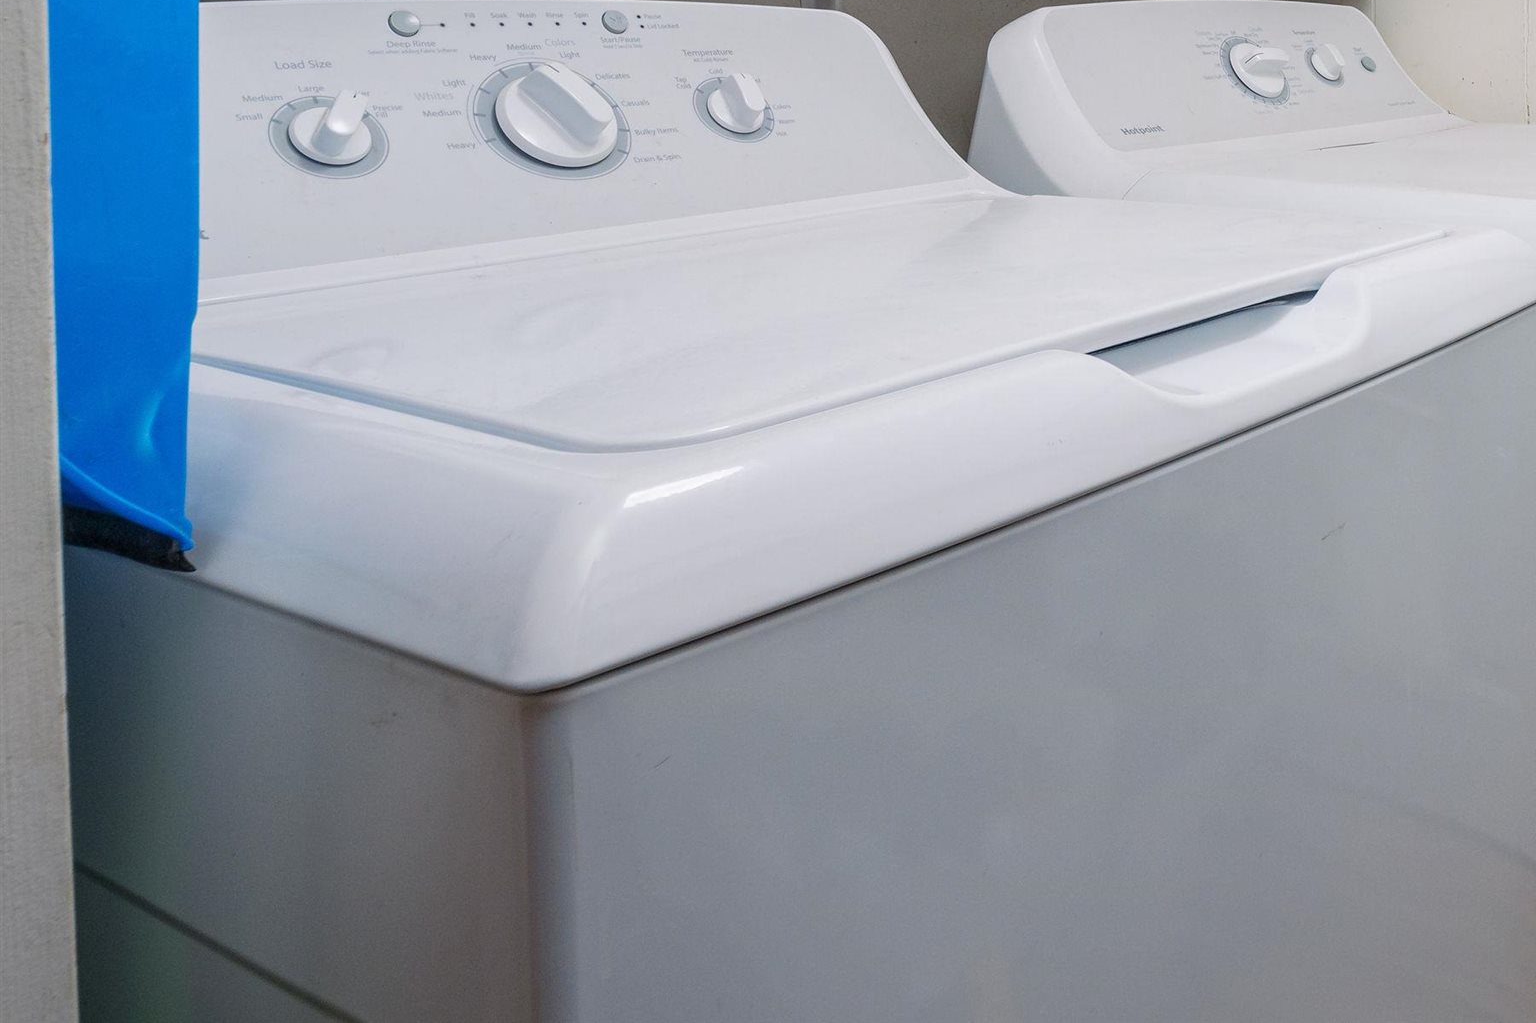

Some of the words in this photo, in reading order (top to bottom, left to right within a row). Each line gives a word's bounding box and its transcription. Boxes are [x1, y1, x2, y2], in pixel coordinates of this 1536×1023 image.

[386, 40, 411, 48] Deep
[544, 38, 576, 47] Colors
[560, 51, 581, 59] Light
[681, 49, 733, 57] Temperature
[274, 60, 305, 70] Load
[308, 59, 333, 69] Size
[442, 79, 466, 88] Light
[298, 85, 324, 93] Large
[242, 94, 283, 102] Medium
[414, 92, 454, 100] Whites
[235, 113, 263, 121] Small
[422, 109, 462, 117] Medium
[1120, 125, 1166, 136] Hotpoint
[446, 142, 476, 150] Heavy
